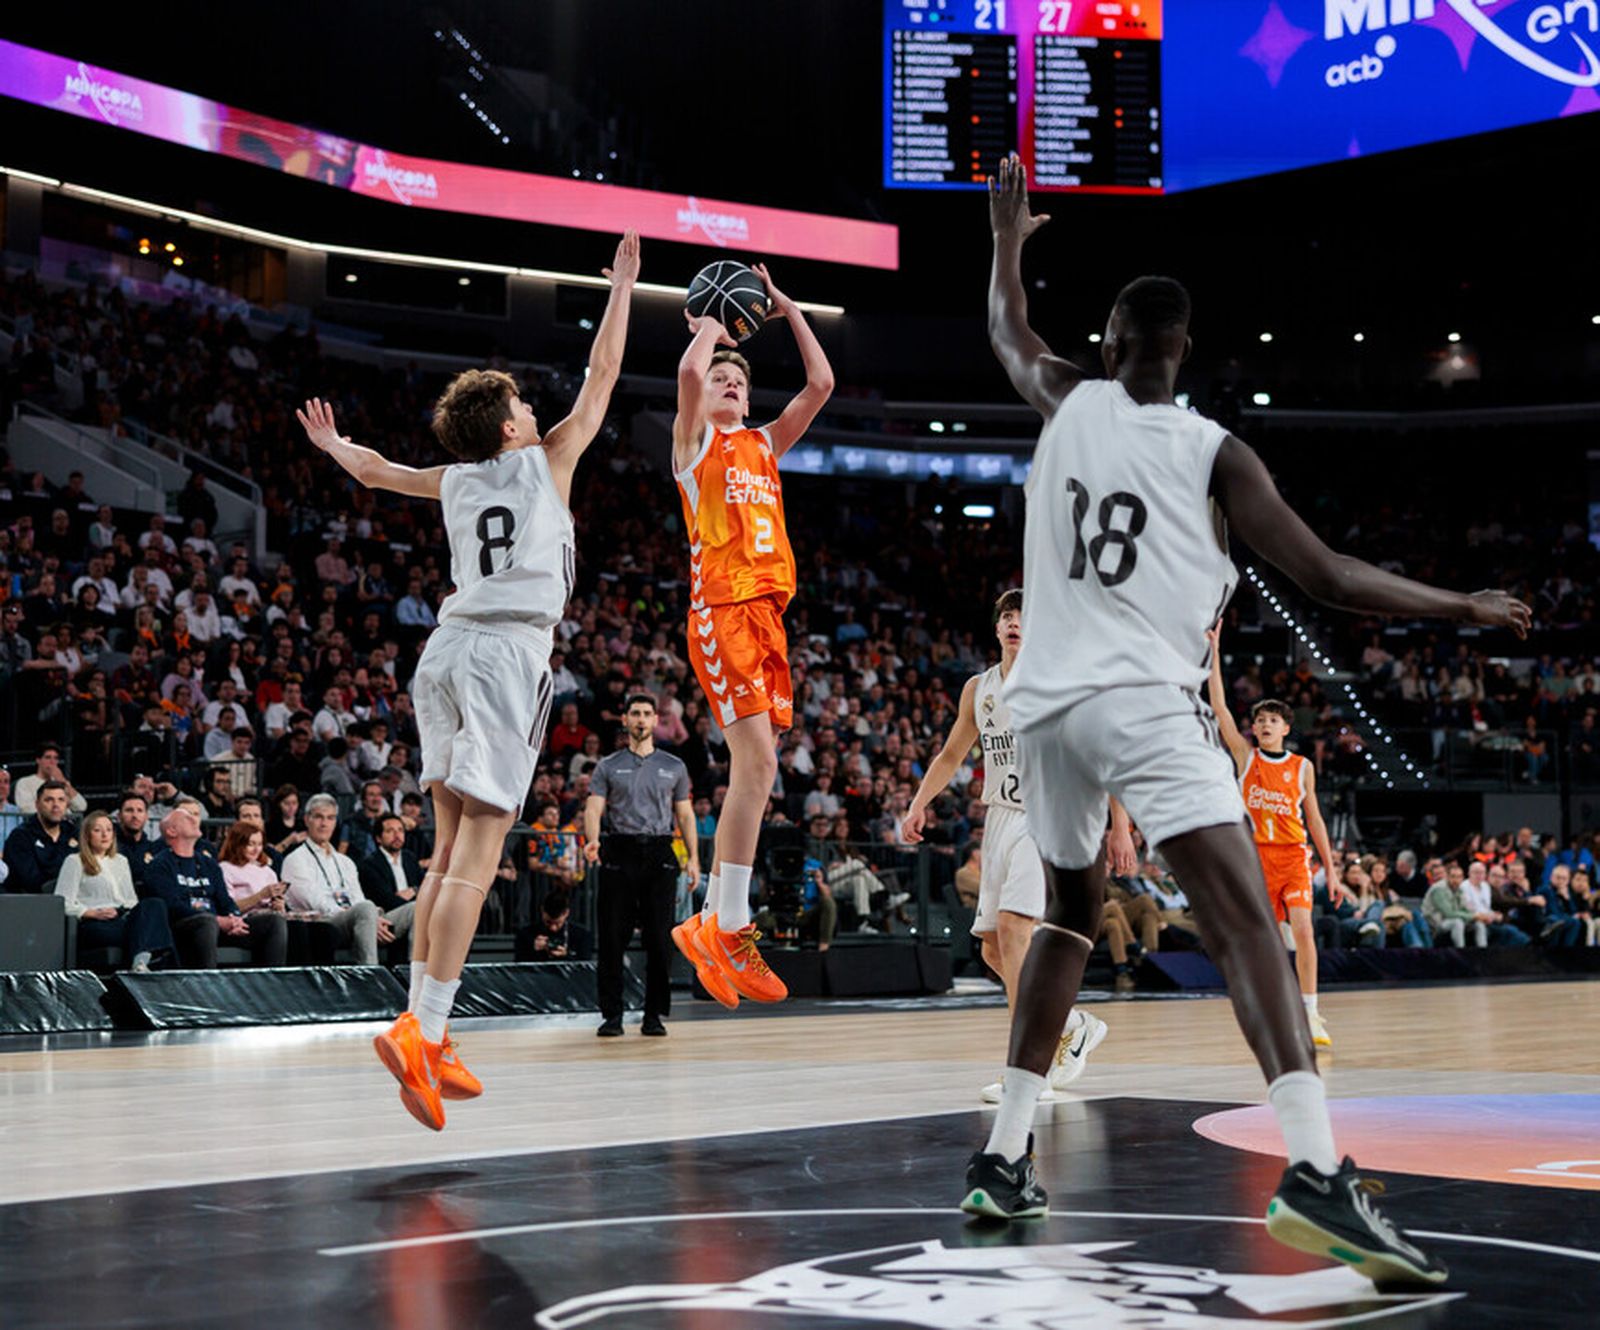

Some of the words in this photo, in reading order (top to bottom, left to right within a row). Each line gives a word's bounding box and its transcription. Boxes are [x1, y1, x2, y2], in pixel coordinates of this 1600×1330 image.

[974, 0, 1006, 30] 21
[1038, 1, 1072, 32] 27
[1325, 54, 1384, 87] acb
[476, 506, 516, 577] 8
[755, 517, 774, 553] 2
[1066, 477, 1148, 588] 18
[1001, 774, 1022, 803] 12
[1266, 818, 1275, 841] 1
